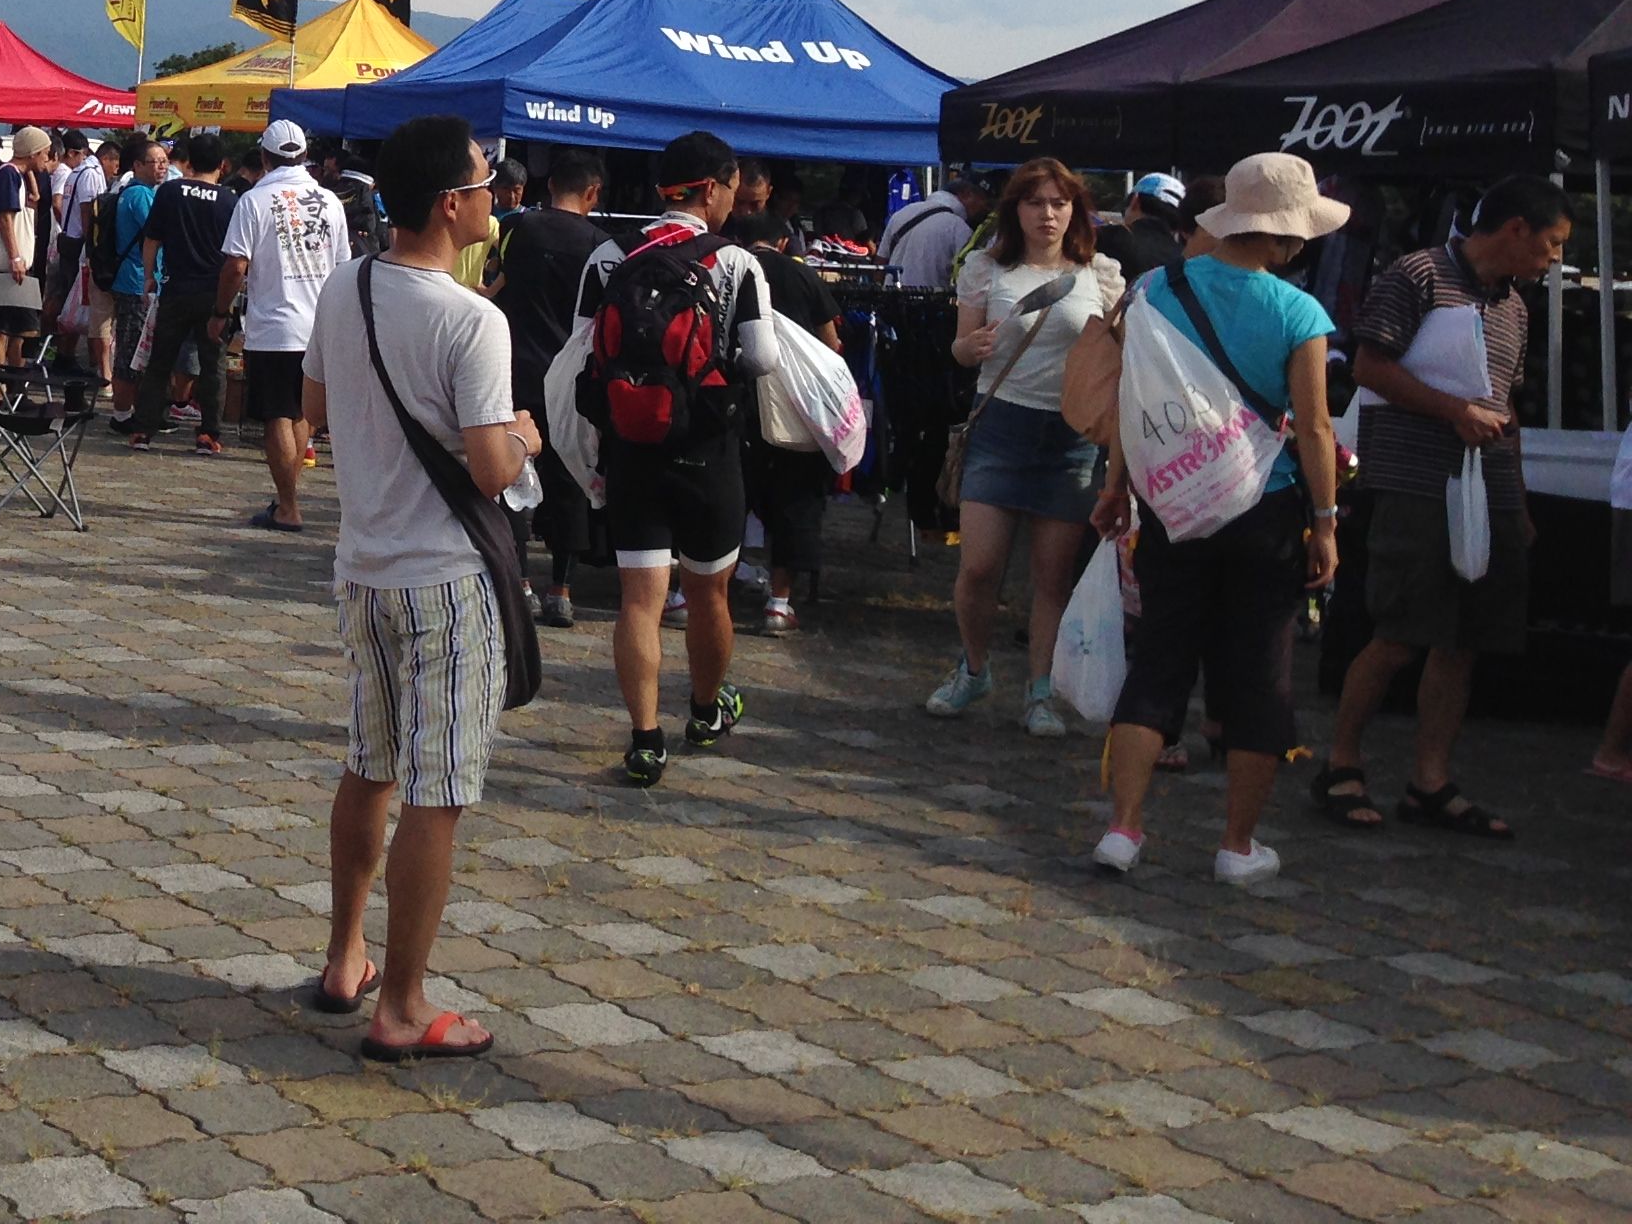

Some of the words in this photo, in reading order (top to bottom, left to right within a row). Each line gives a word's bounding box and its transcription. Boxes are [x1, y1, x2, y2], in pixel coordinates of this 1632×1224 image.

[660, 27, 794, 63] Wind
[801, 41, 871, 70] Up
[526, 101, 581, 123] Wind
[587, 107, 616, 129] Up
